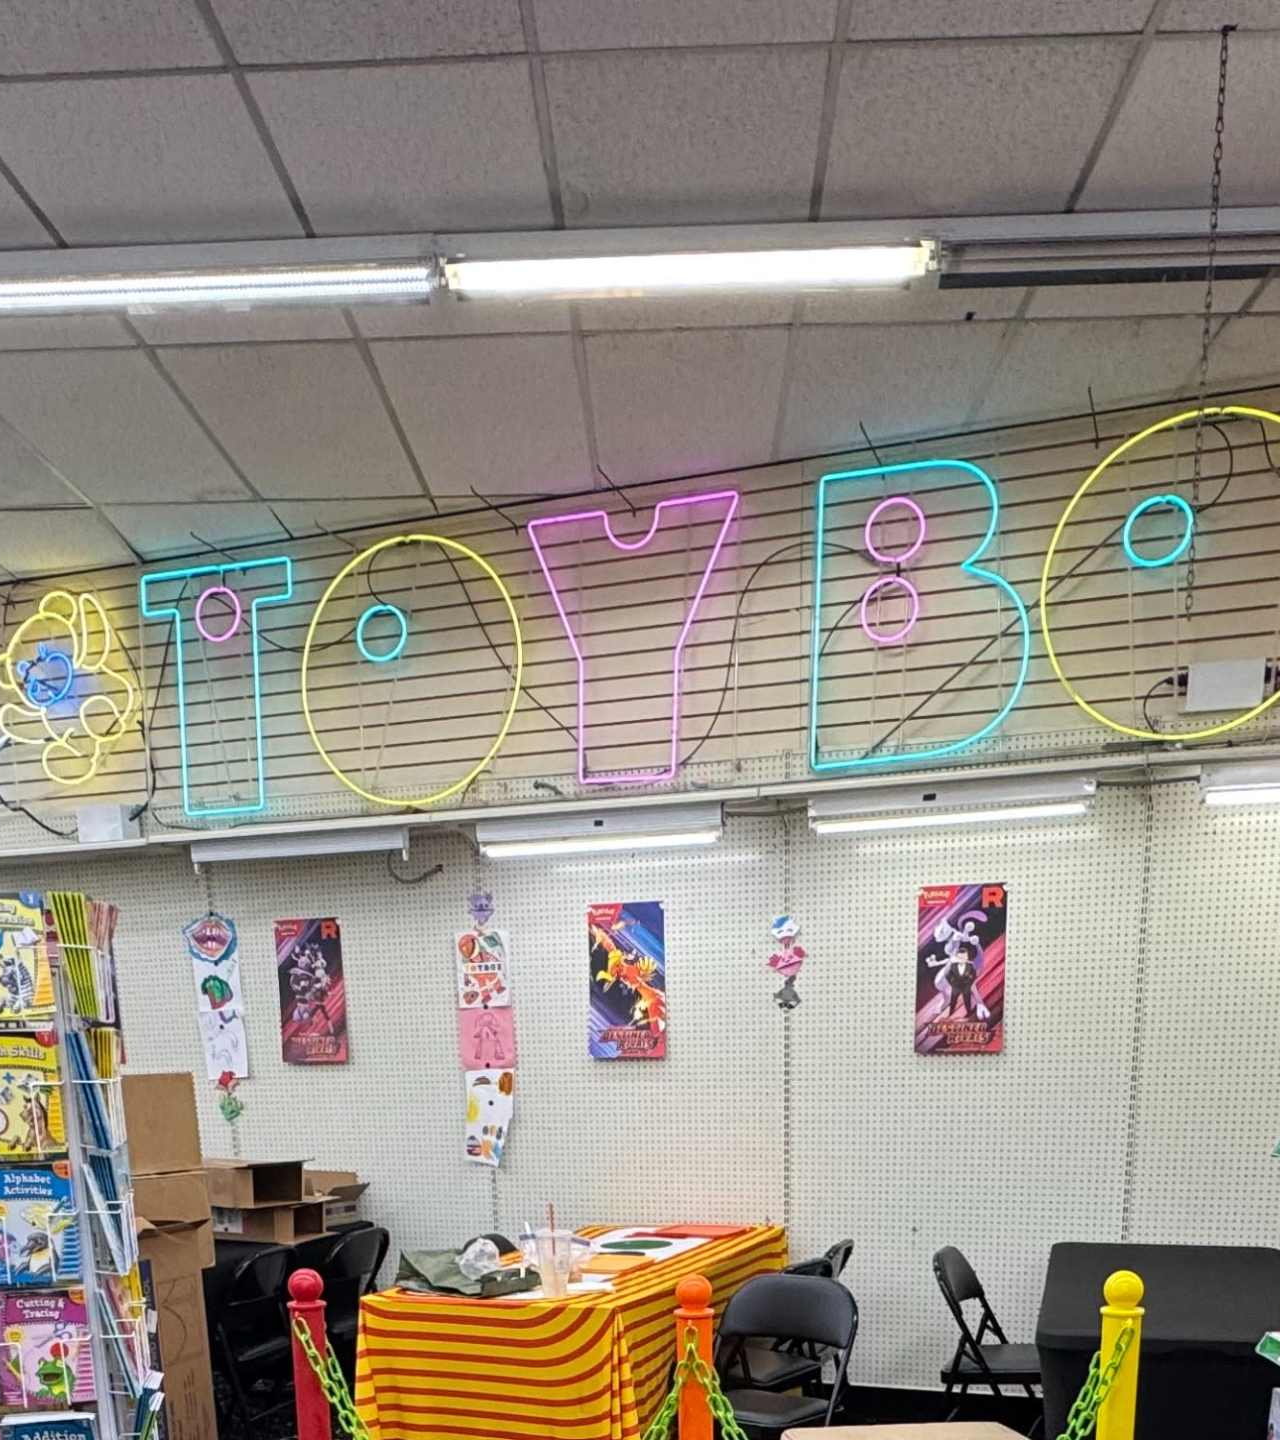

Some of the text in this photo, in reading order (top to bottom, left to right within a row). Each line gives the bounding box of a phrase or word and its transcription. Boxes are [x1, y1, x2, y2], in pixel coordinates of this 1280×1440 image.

[140, 490, 738, 816] TOY
[3, 1173, 51, 1186] Alphabet
[3, 1185, 53, 1196] Activities
[15, 1298, 56, 1309] Cutting
[22, 1309, 61, 1320] Tracing
